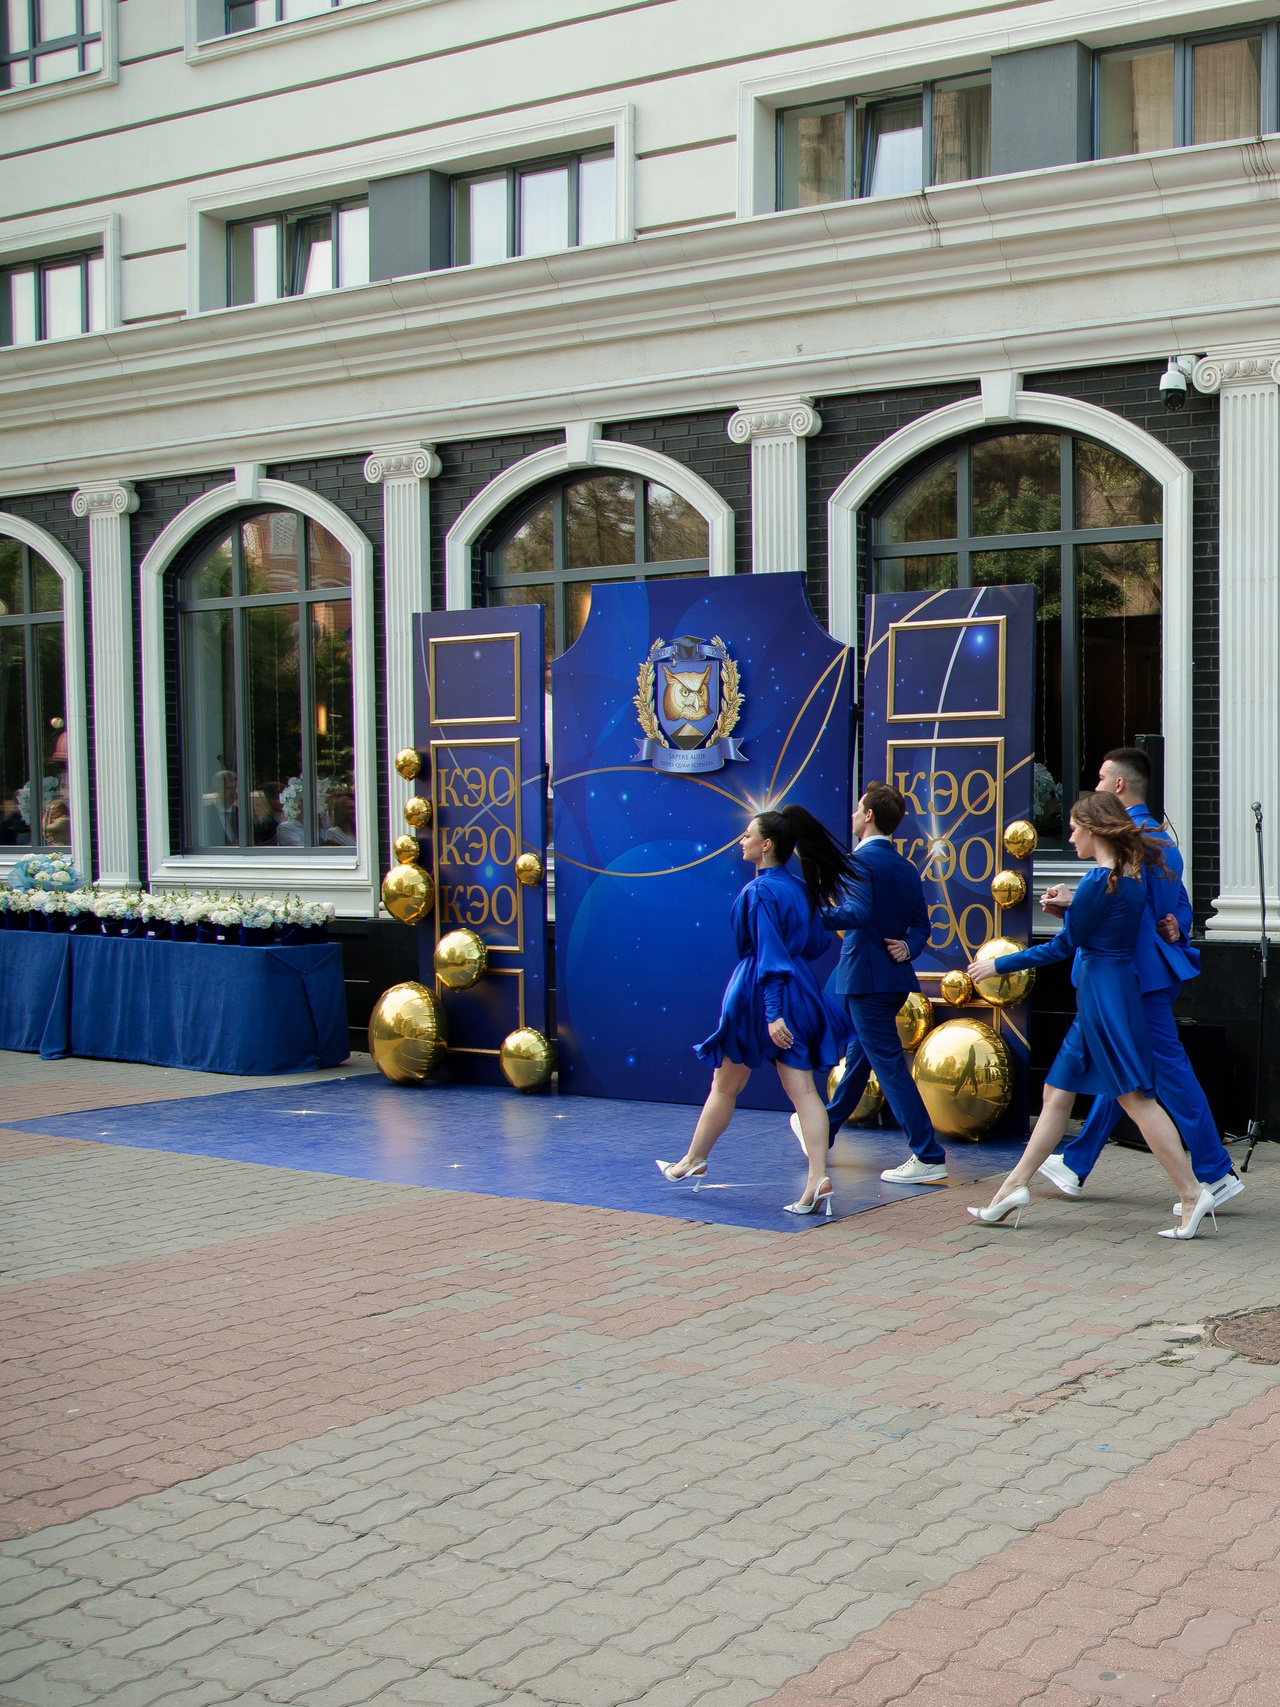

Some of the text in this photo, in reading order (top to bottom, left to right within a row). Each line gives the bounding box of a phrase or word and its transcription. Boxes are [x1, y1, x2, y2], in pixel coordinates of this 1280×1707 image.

[437, 766, 515, 807] КЭО
[895, 769, 996, 816] КЭО
[439, 825, 516, 866] КЭО
[440, 885, 518, 925] КЭО
[926, 903, 994, 949] ЭО
